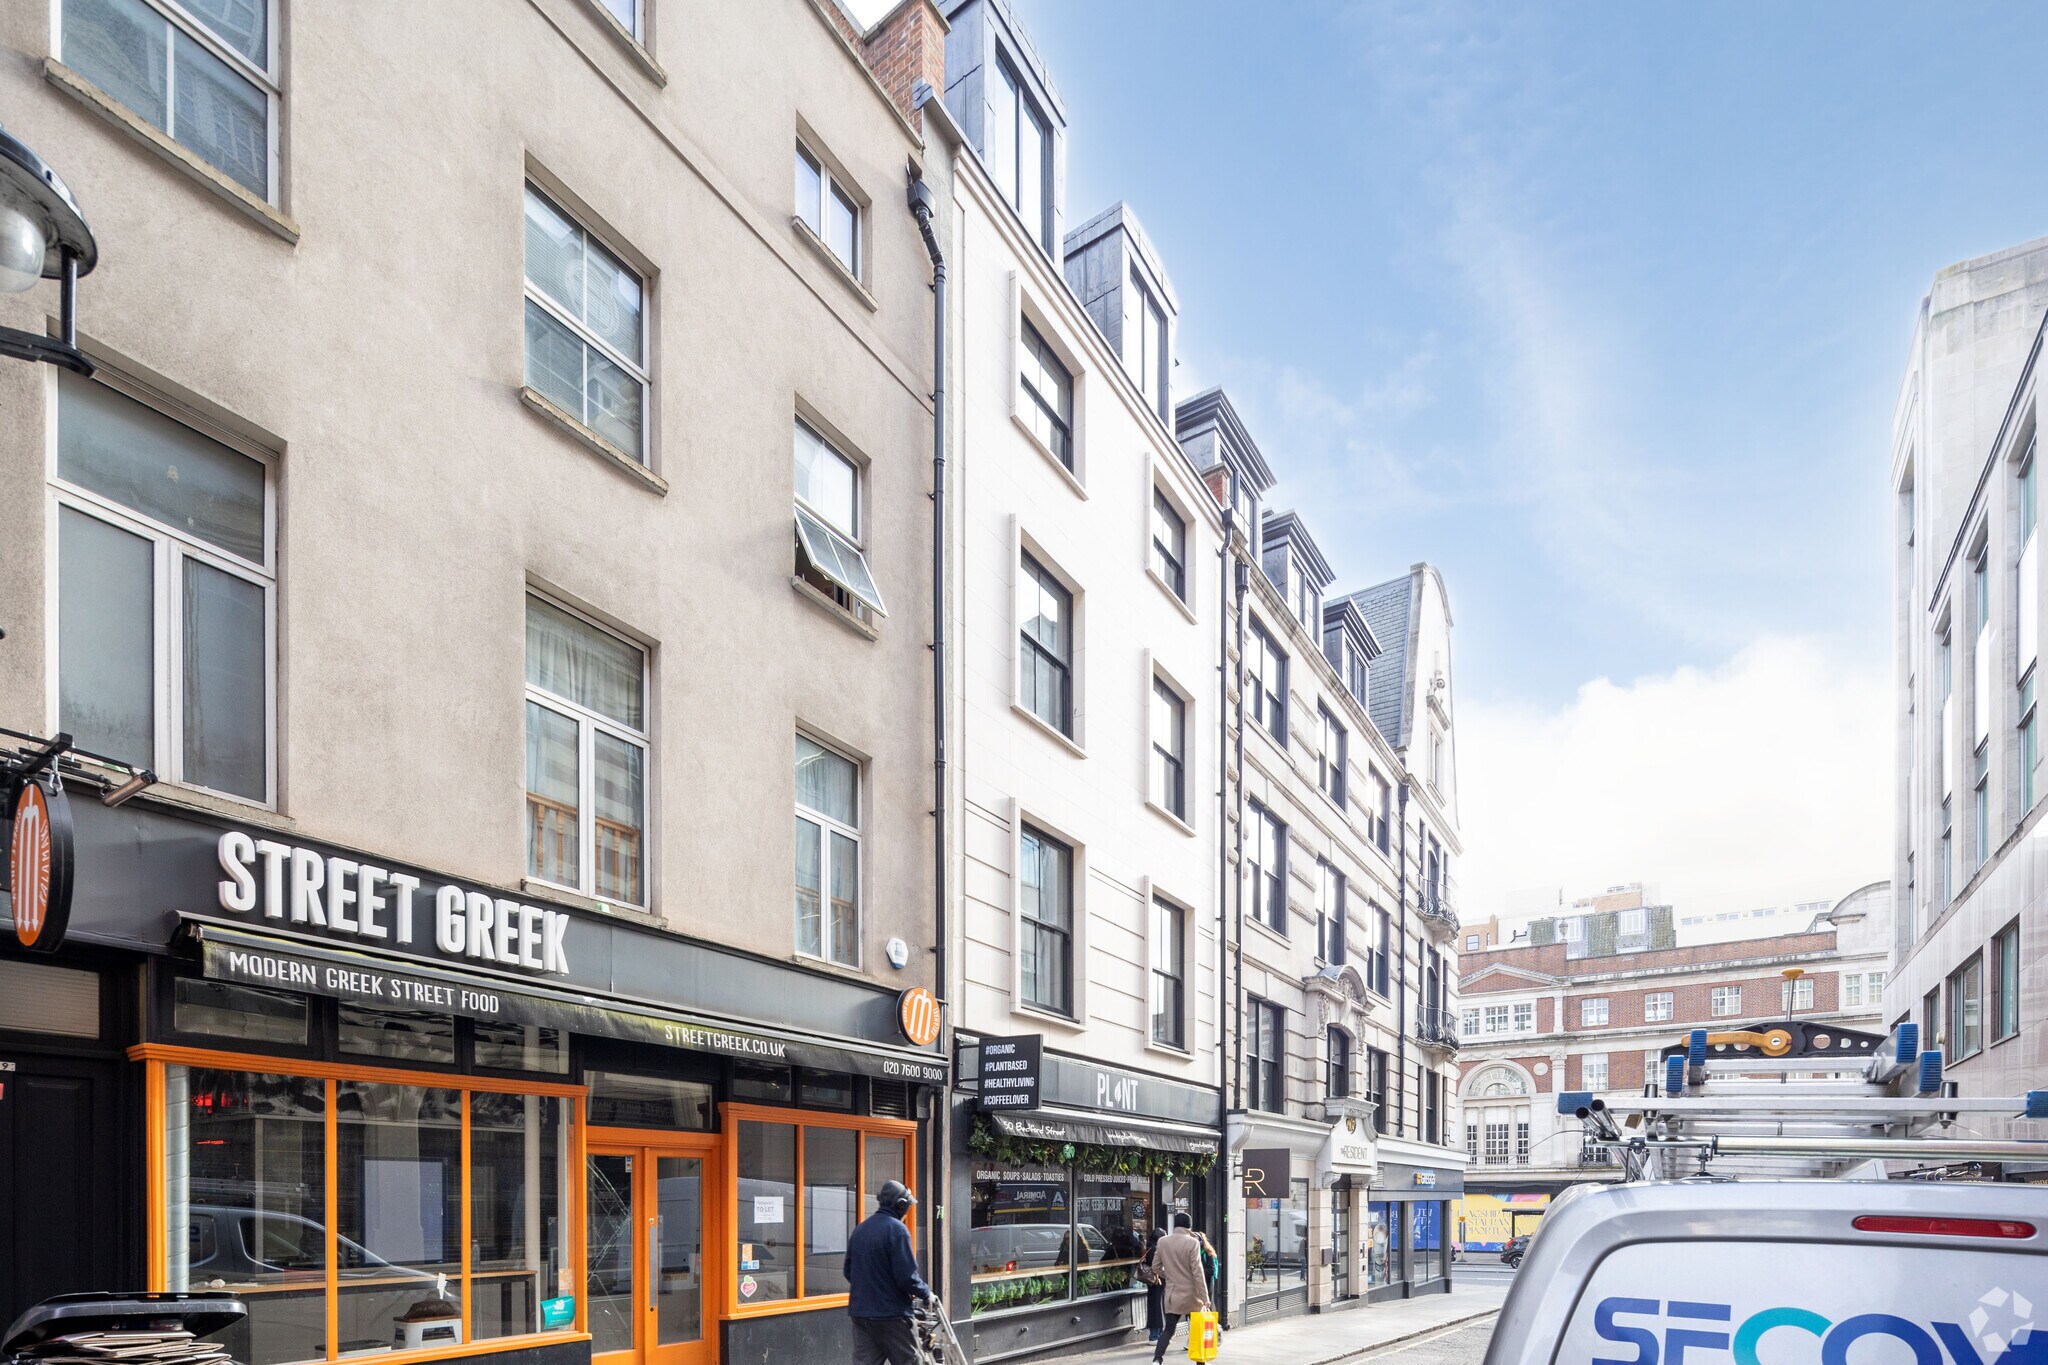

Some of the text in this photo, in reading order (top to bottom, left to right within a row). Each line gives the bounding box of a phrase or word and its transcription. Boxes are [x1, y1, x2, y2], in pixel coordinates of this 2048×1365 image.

[218, 831, 570, 976] STREET GREEK
[230, 951, 499, 1013] MODERN GREEK STREET FOOD
[664, 1024, 786, 1058] STREETGREEK.CO.UK
[985, 1044, 1015, 1055] #ORGANIC
[883, 1060, 943, 1081] 020 7600 9000
[984, 1060, 1027, 1072] #PLANTBASED
[984, 1076, 1034, 1089] #HEALTHYLIVING
[983, 1093, 1029, 1105] #COFFEELOVER
[1343, 1145, 1368, 1160] RESIDENT
[976, 1170, 1001, 1180] ORGANIC
[1083, 1173, 1095, 1182] COLD
[1095, 1174, 1113, 1183] PRESSED
